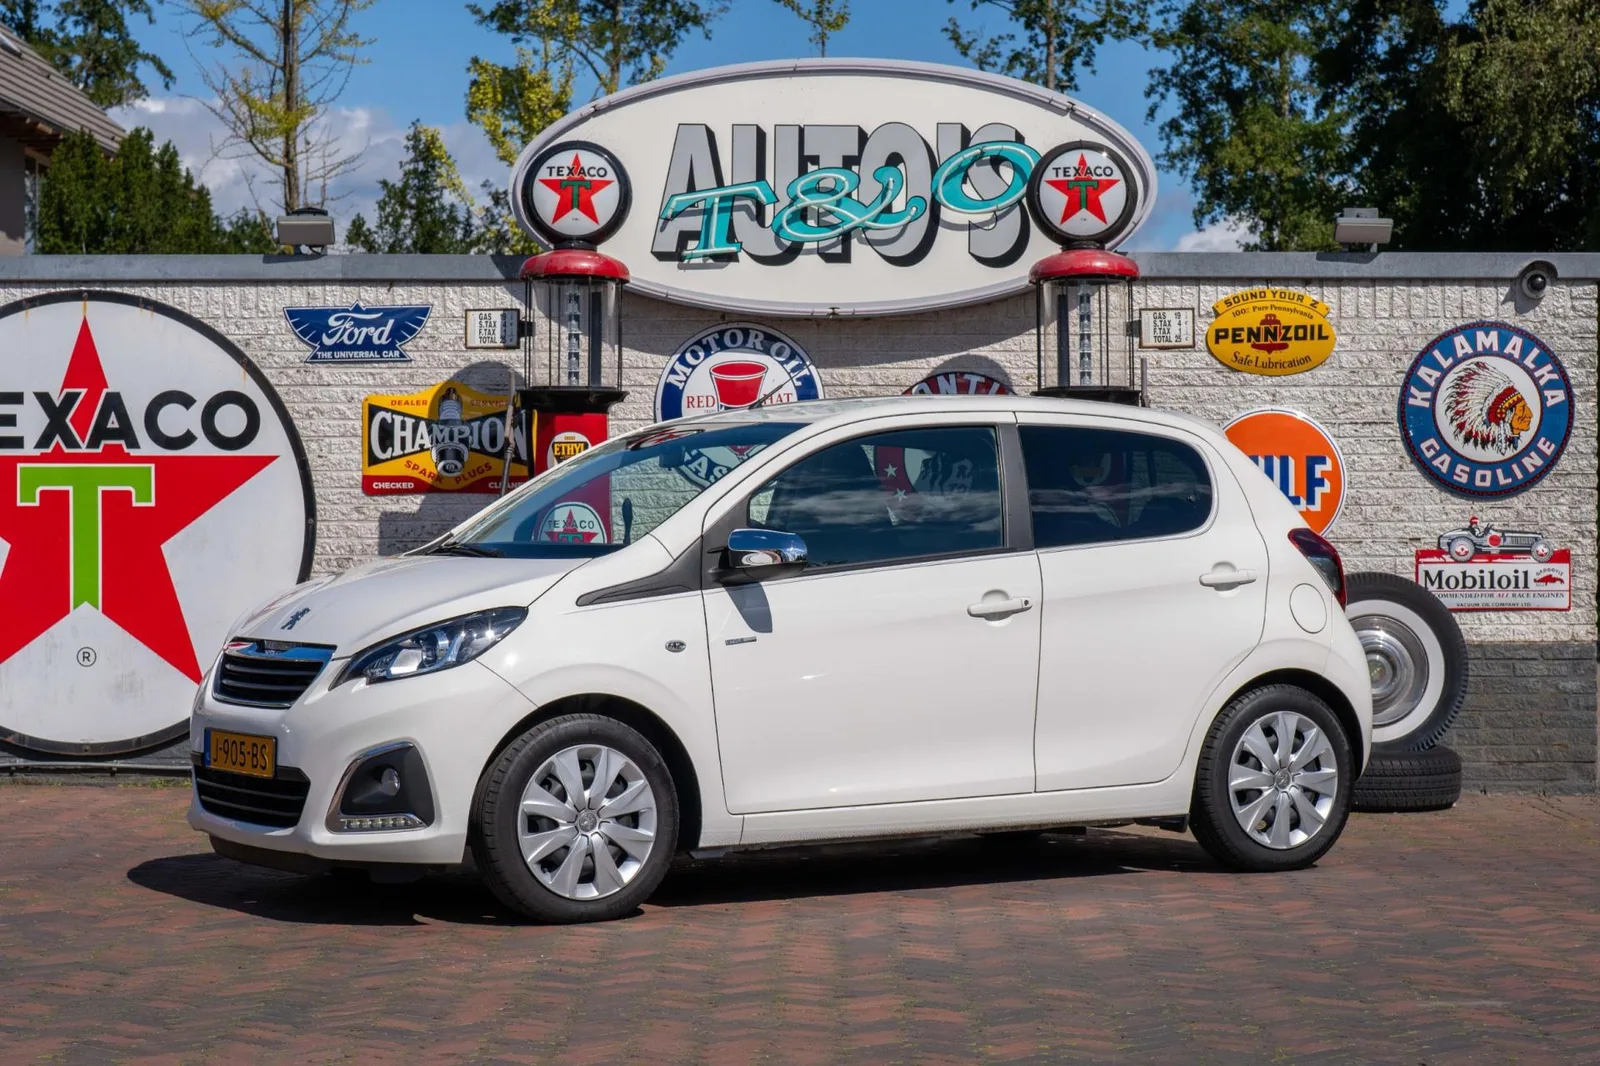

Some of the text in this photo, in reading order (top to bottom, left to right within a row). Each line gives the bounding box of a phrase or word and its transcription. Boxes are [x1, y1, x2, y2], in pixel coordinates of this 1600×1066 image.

[546, 166, 608, 178] TEXACO
[1052, 166, 1114, 178] TEXACO
[651, 122, 1030, 268] AUTO'S
[1224, 290, 1320, 309] SOUND YOUR Z
[478, 313, 492, 321] GAS
[1152, 312, 1167, 320] GAS
[1252, 304, 1269, 313] Pure
[1270, 304, 1314, 320] Pennsylvania
[321, 312, 396, 346] Ford
[1152, 320, 1172, 328] S.TAX
[478, 336, 498, 344] TOTAL
[1152, 335, 1173, 343] TOTAL
[1214, 324, 1330, 344] PENNZOIL
[317, 350, 400, 359] THE UNIVERSAL CAR
[666, 329, 811, 391] MOTOR OIL
[1231, 350, 1312, 369] Safe Lubrication
[1408, 330, 1566, 408] KALAMALKA
[686, 392, 794, 408] RED HAT
[370, 409, 528, 461] CHAMPION
[1420, 437, 1556, 487] GASOLINE
[404, 460, 493, 485] SPARK PLUGS
[488, 481, 523, 489] CLAN
[547, 520, 595, 529] TEXACO
[1423, 569, 1531, 590] Mobiloil
[1512, 591, 1531, 599] RACE
[1533, 591, 1565, 599] ENGINES
[213, 737, 269, 771] J-905-BS
